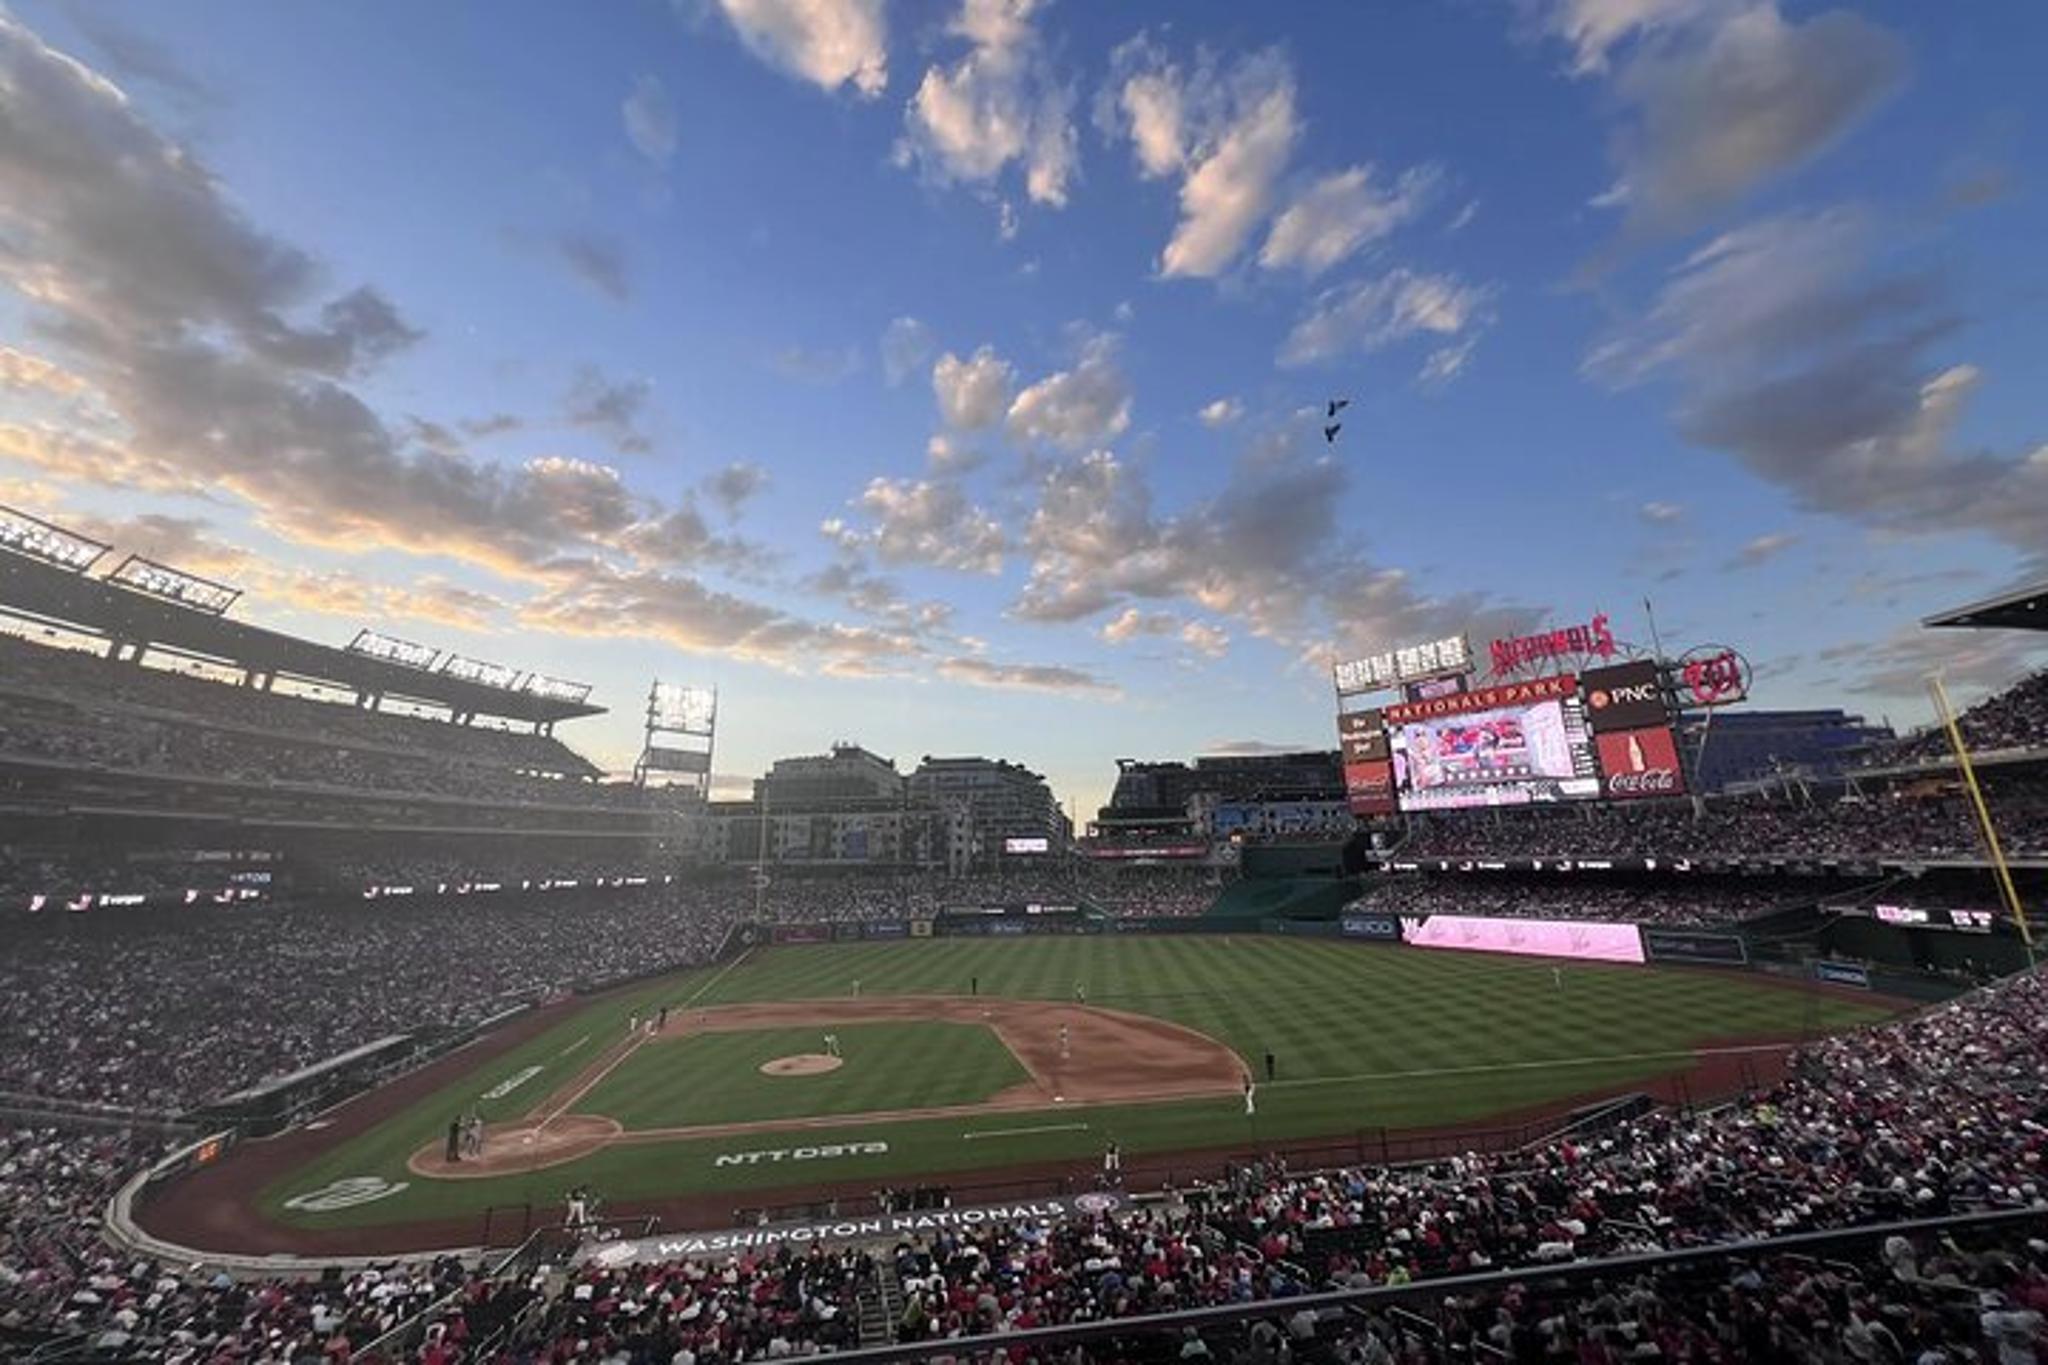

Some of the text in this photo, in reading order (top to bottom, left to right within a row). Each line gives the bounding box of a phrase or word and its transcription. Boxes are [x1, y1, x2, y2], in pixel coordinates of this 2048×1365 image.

[1390, 680, 1564, 720] NATIONALS PARK
[1611, 683, 1656, 704] PNC
[1609, 768, 1674, 793] Coca-Cola
[715, 1149, 790, 1167] NTT
[658, 1219, 881, 1255] WASHINGTON
[892, 1202, 1065, 1230] NATIONALS
